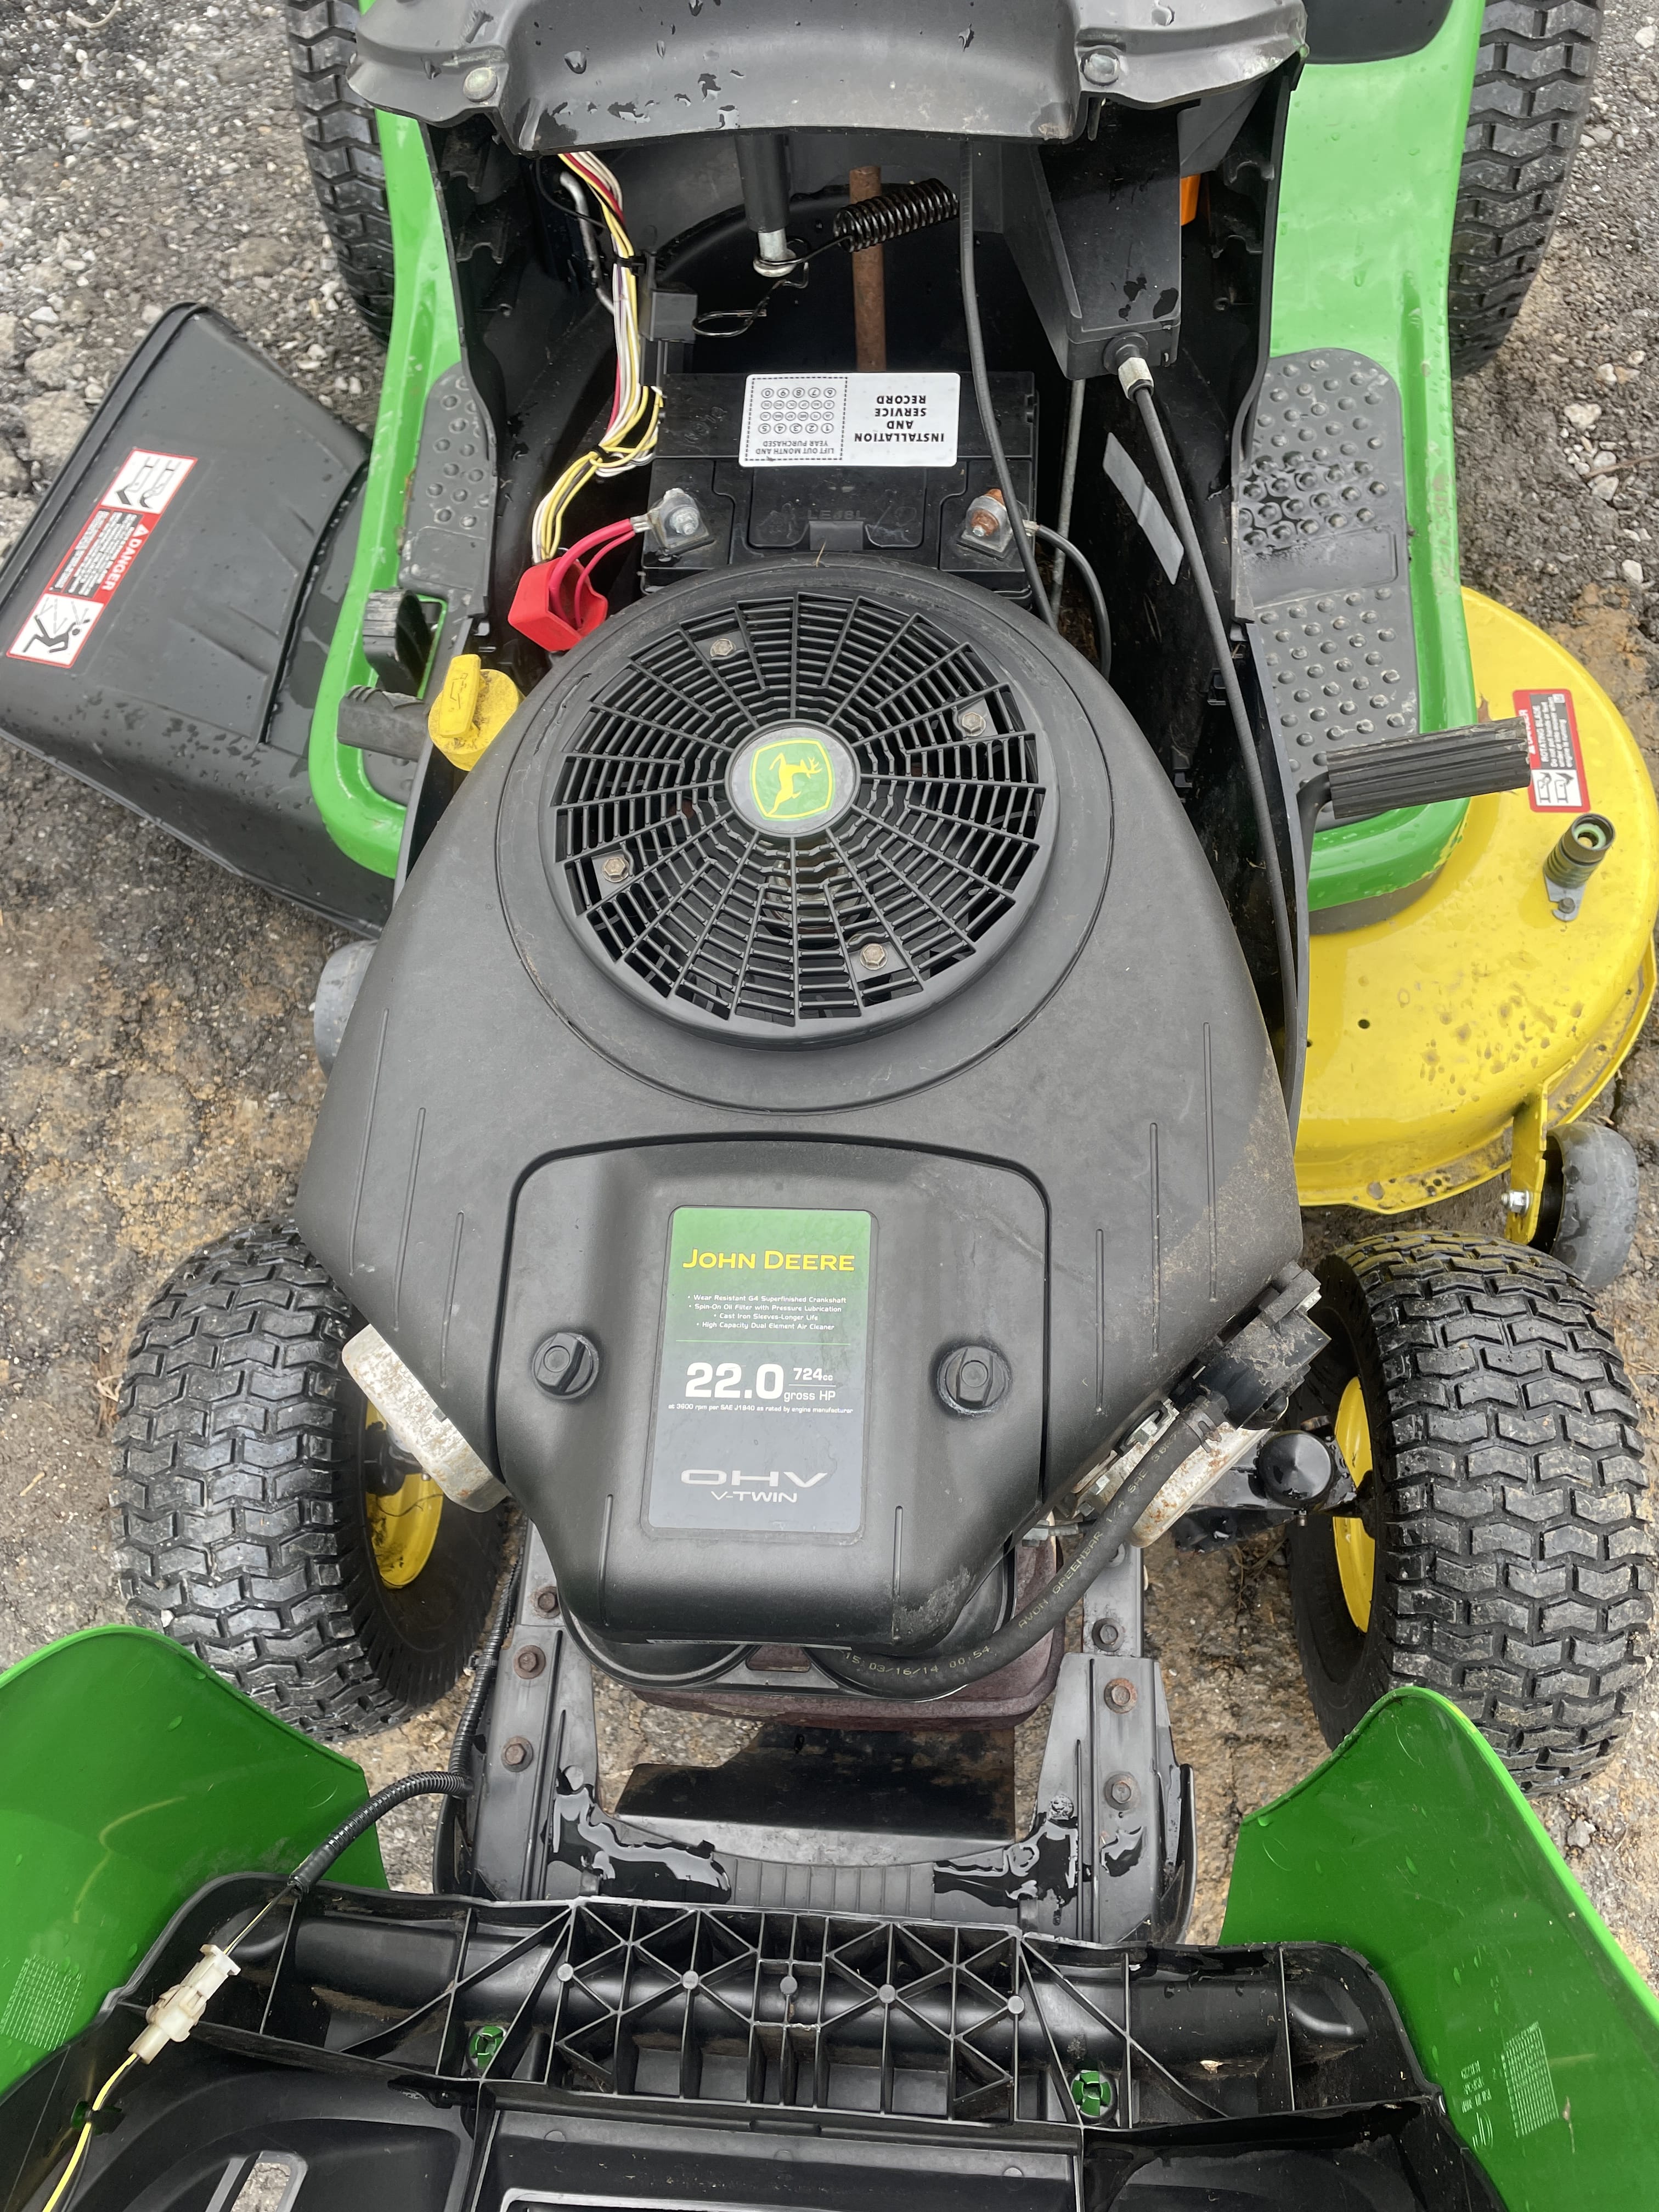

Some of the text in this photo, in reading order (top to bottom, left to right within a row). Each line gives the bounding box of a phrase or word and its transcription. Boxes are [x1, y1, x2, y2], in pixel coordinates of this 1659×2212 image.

[877, 396, 926, 404] RECORD
[875, 408, 927, 417] SERVICE
[887, 421, 913, 429] AND
[855, 433, 944, 442] INSTALLATION
[100, 538, 144, 591] DANGER
[682, 1249, 855, 1272] JOHN DEERE
[753, 1313, 804, 1322] Sleeves-Longer
[793, 1368, 833, 1381] 724cc
[685, 1362, 783, 1400] 22.0
[784, 1391, 836, 1402] gross HP
[681, 1469, 828, 1488] OHV
[711, 1491, 797, 1503] V-TWIN
[870, 1662, 939, 1675] 03/16/14
[949, 1645, 990, 1668] 00:54
[1018, 1598, 1048, 1628] AVON
[1052, 1531, 1103, 1594] GREENBAR
[1127, 1470, 1149, 1493] SAE
